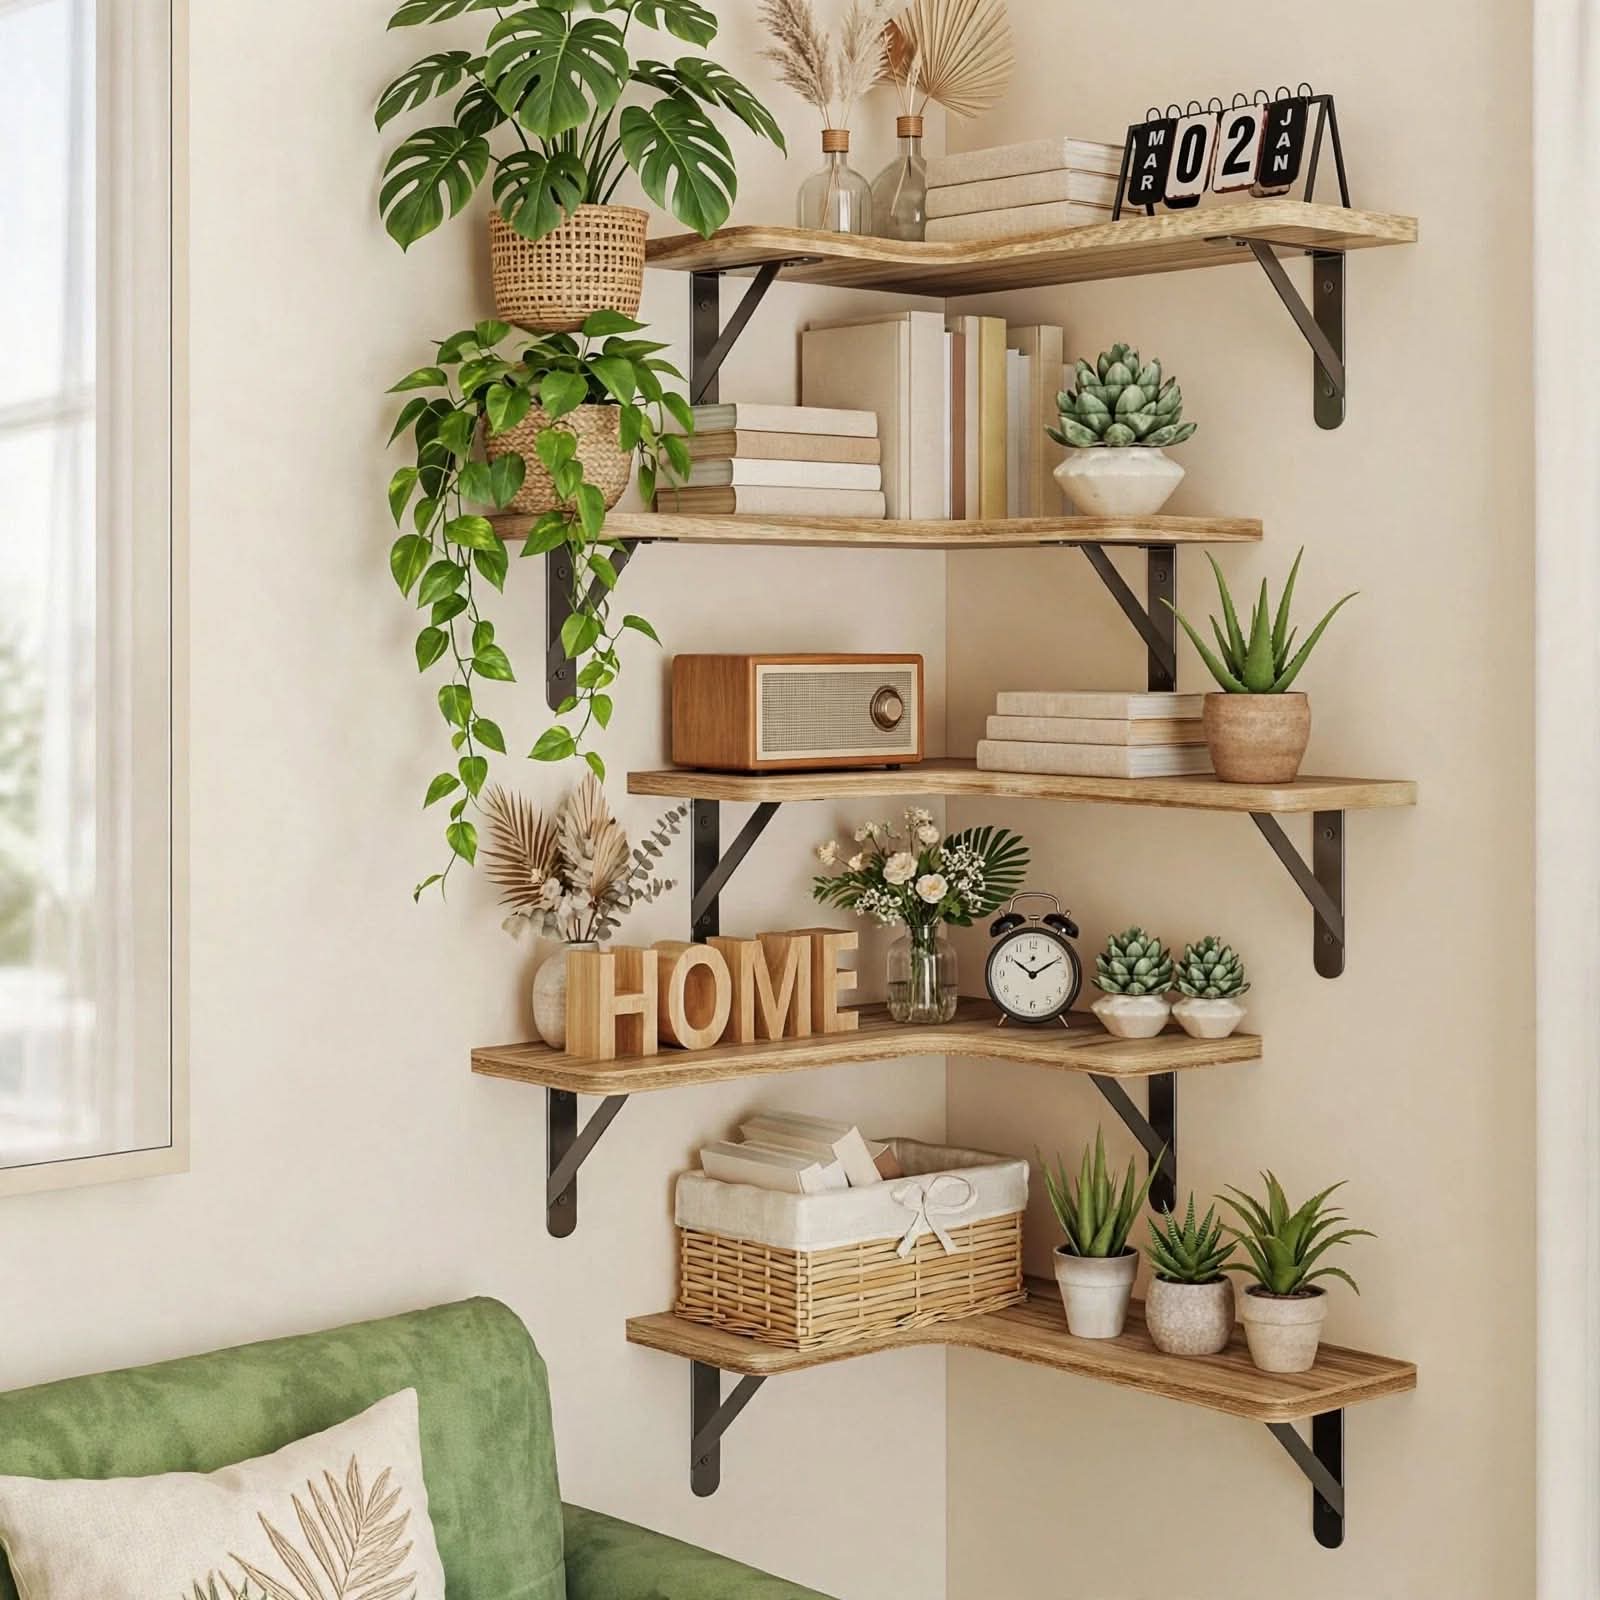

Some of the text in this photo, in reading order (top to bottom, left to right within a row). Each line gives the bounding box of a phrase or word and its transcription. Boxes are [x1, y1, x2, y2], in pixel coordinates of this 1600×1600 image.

[1140, 129, 1165, 191] MAR
[1273, 108, 1292, 172] JAN
[566, 928, 859, 1060] HOME
